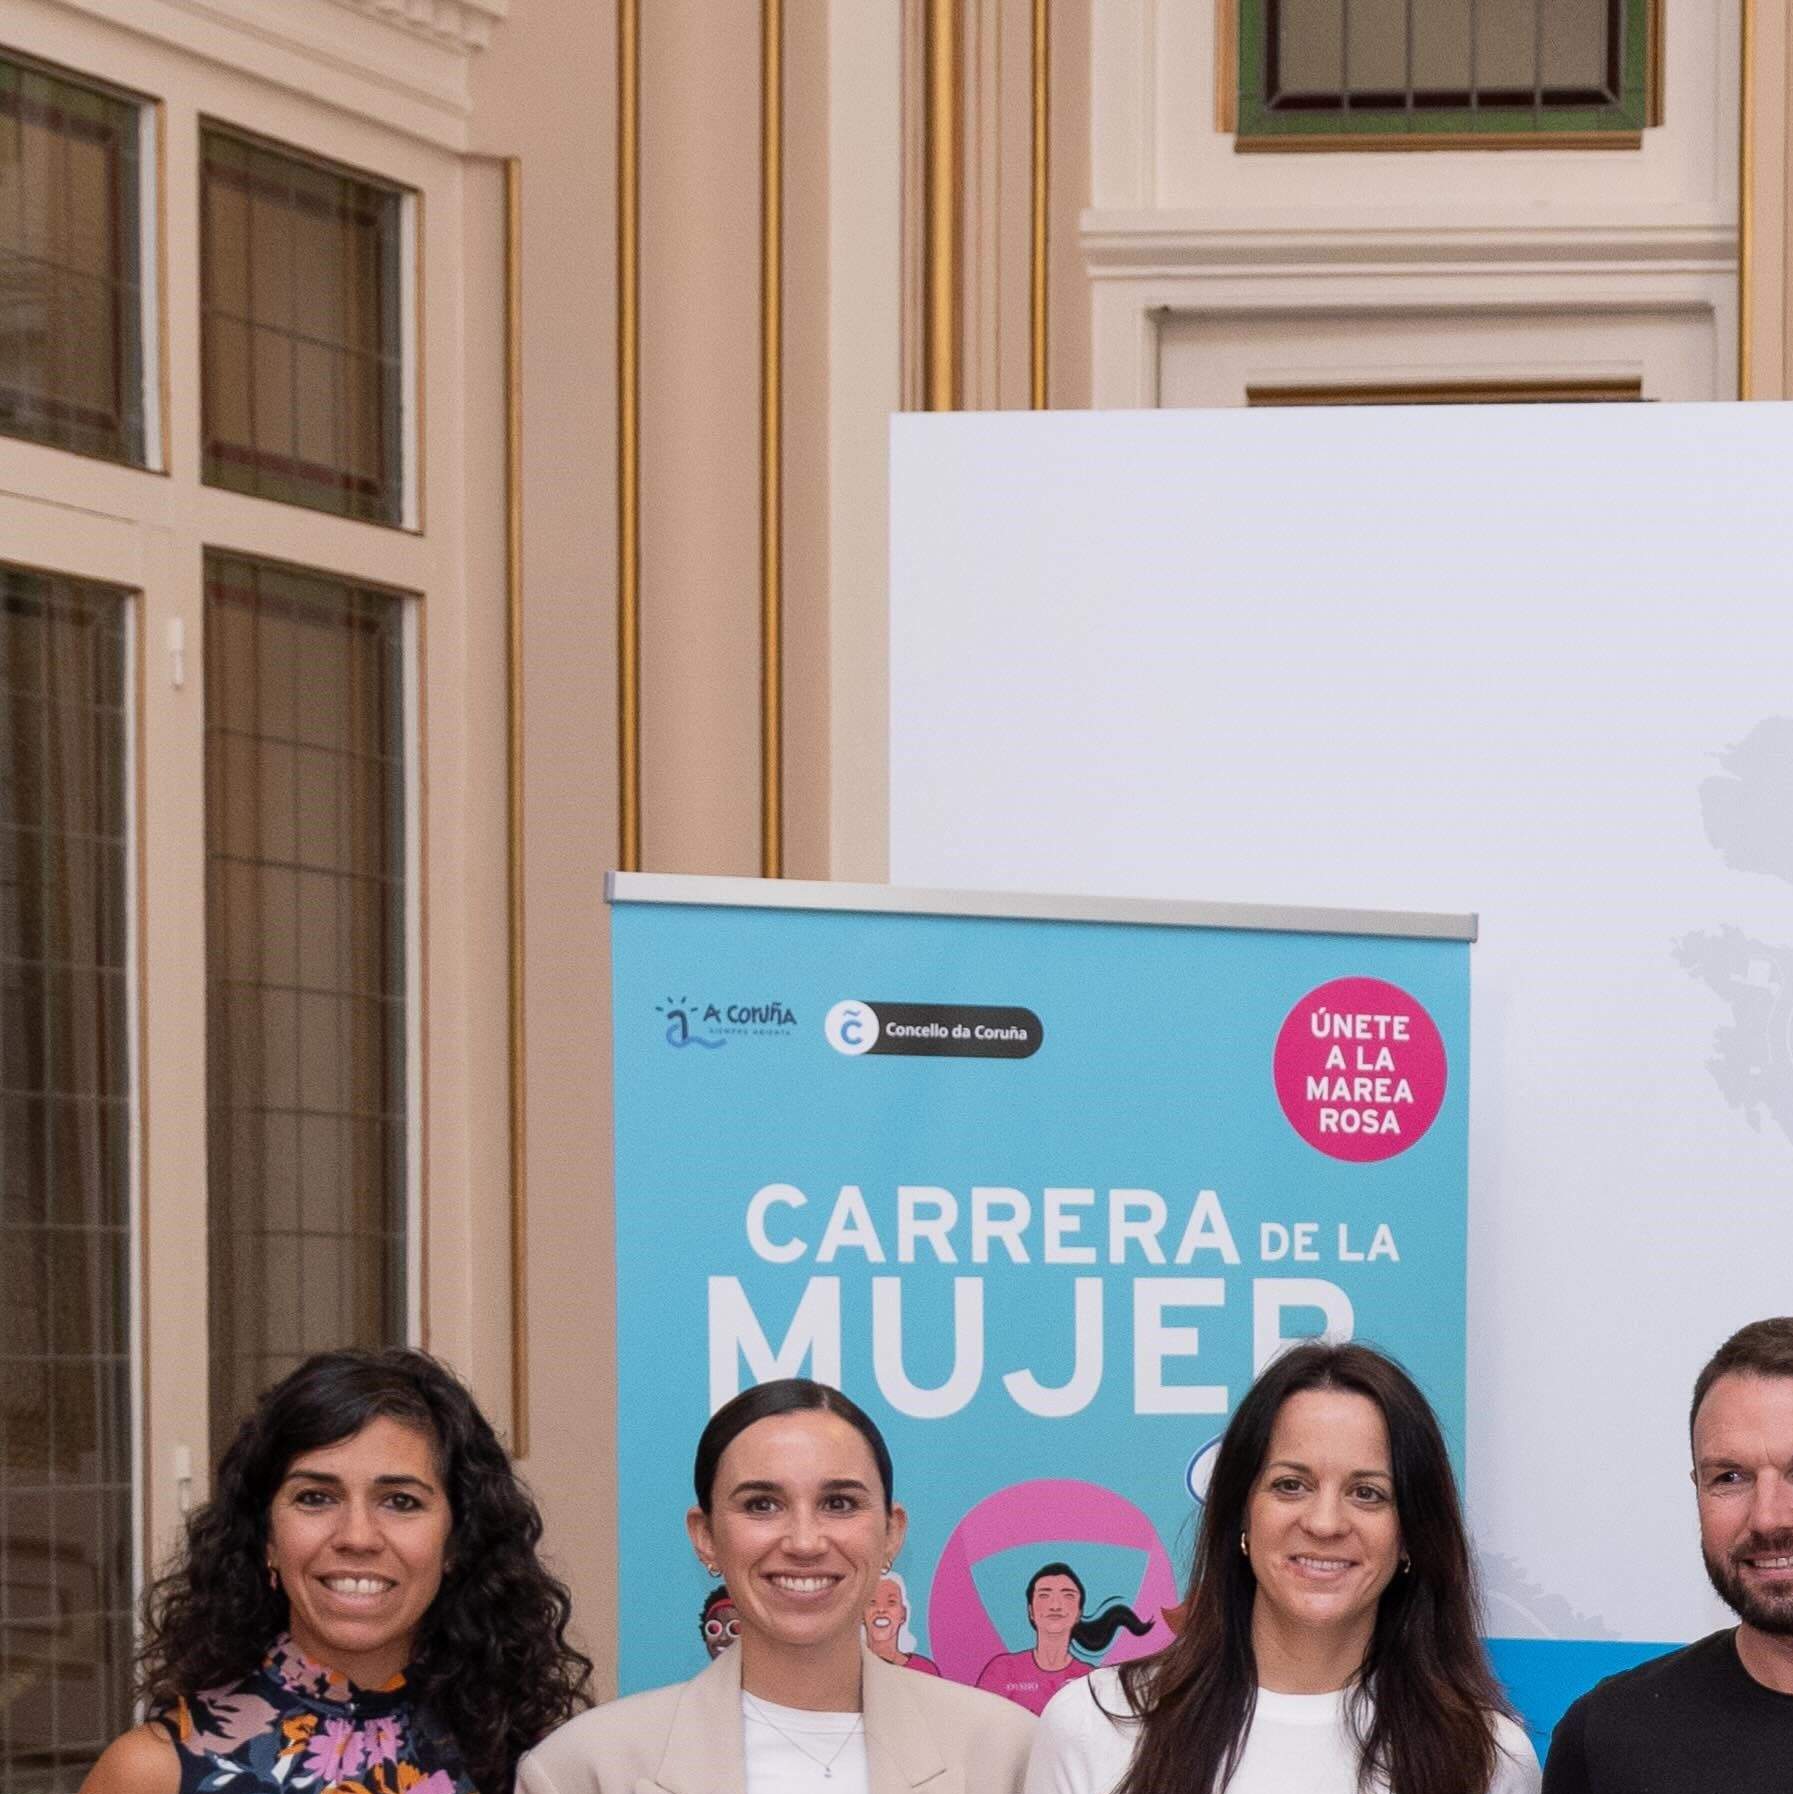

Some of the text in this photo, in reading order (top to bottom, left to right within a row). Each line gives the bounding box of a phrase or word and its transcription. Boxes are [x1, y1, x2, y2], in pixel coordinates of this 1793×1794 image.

[886, 1022, 1027, 1041] Concello da Coruña
[1311, 1007, 1410, 1040] ÚNETE
[1325, 1045, 1395, 1072] A LA
[1306, 1076, 1414, 1104] MAREA
[1319, 1108, 1400, 1134] ROSA
[745, 1183, 1400, 1264] CARRERA DE LA
